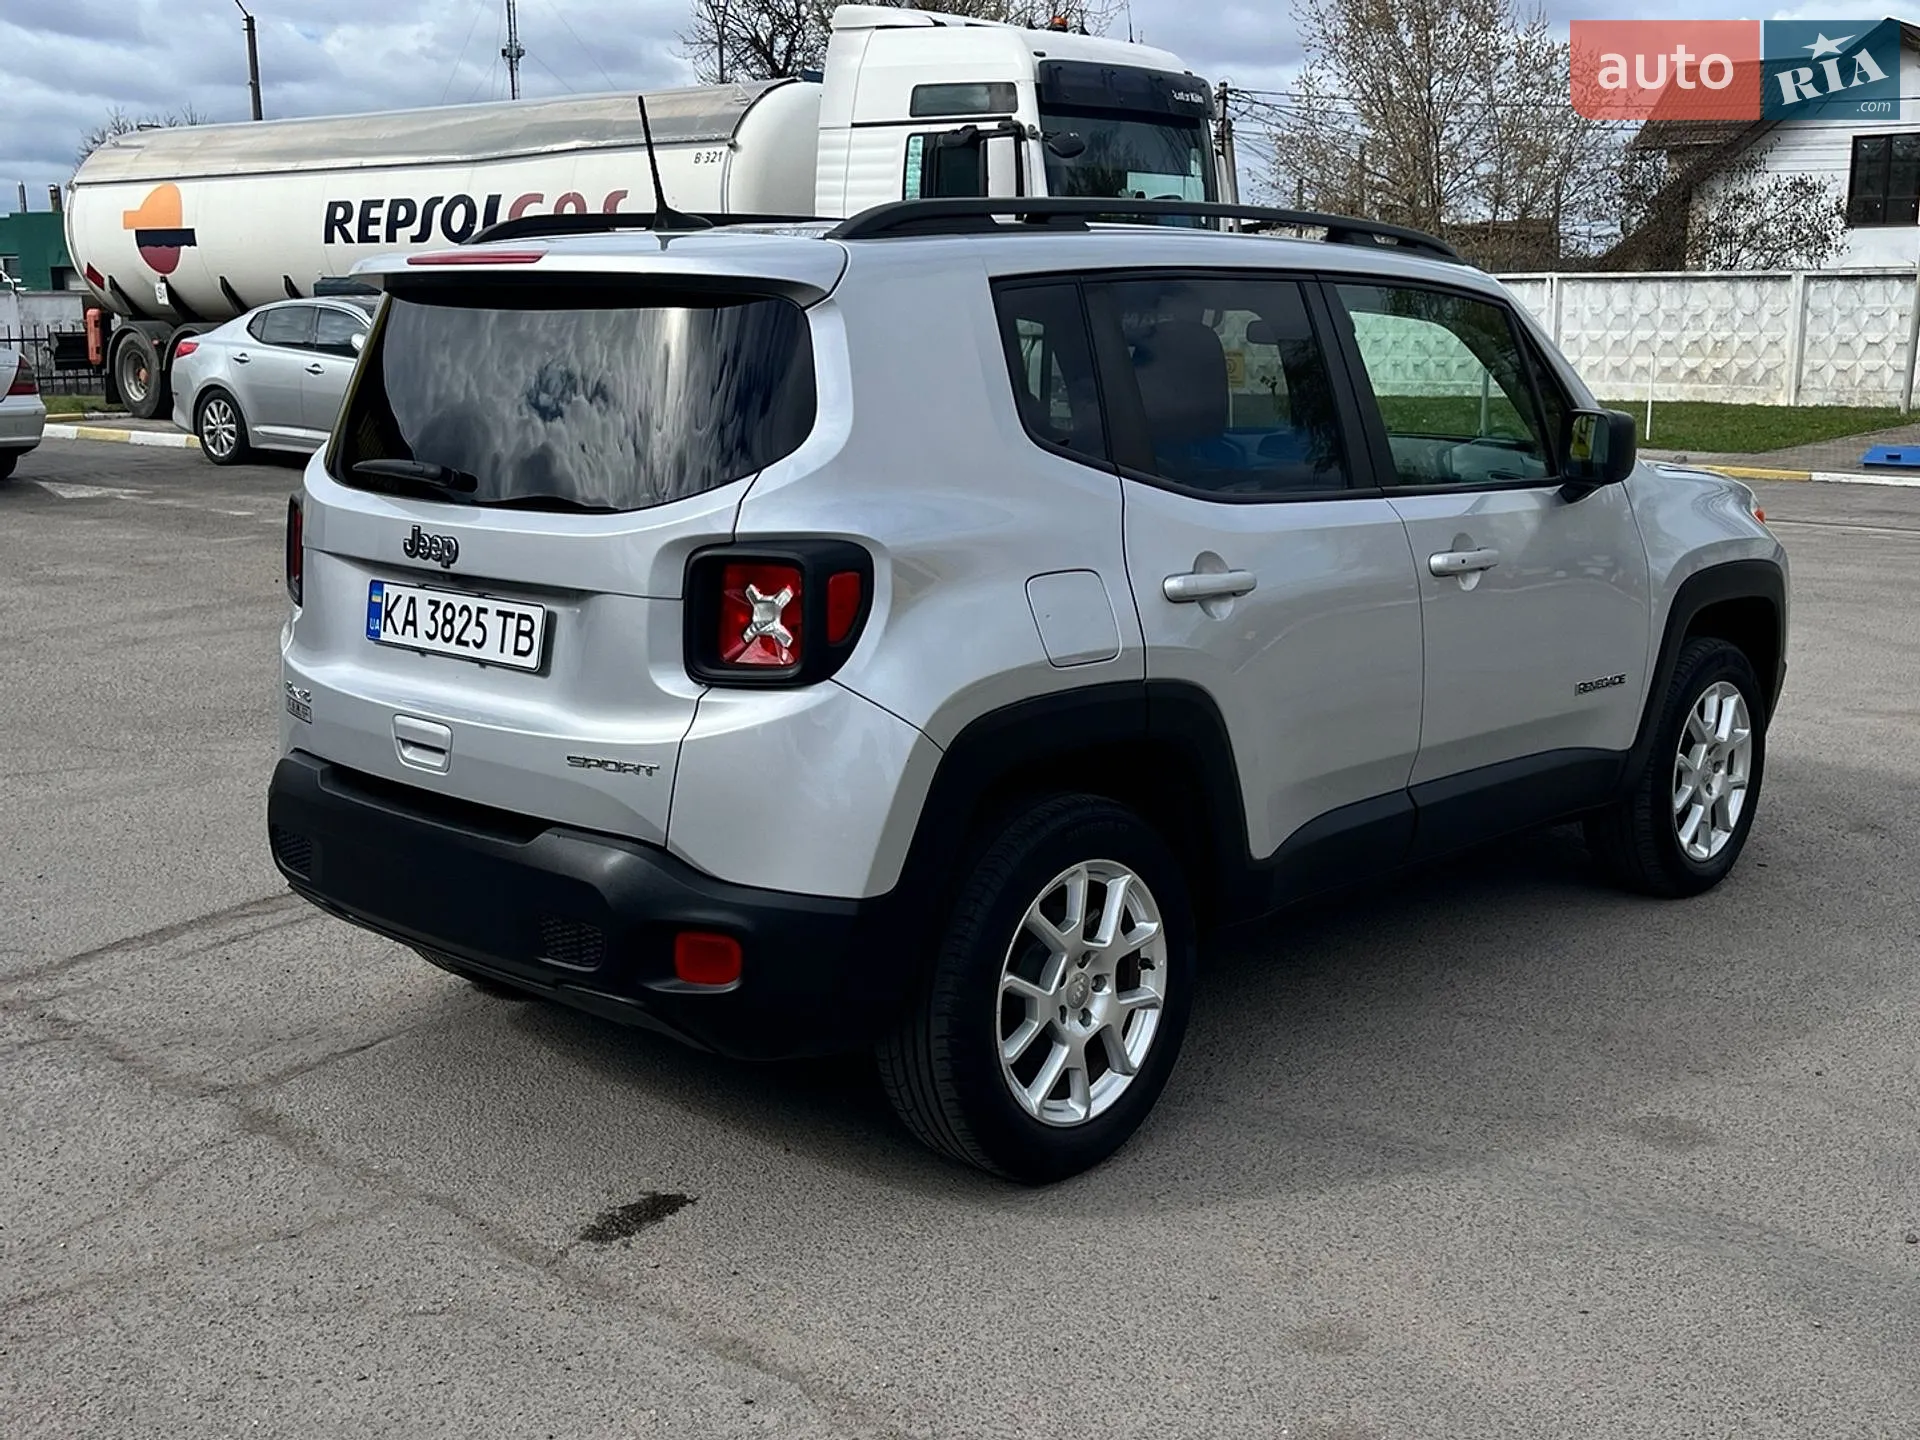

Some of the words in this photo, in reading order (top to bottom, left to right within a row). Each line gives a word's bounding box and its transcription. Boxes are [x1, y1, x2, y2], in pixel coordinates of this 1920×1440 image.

[403, 525, 459, 568] Jeep
[370, 617, 380, 631] UA
[383, 591, 418, 638] KA
[425, 598, 488, 650] 3825
[496, 609, 535, 657] TB
[566, 755, 660, 777] SPORT
